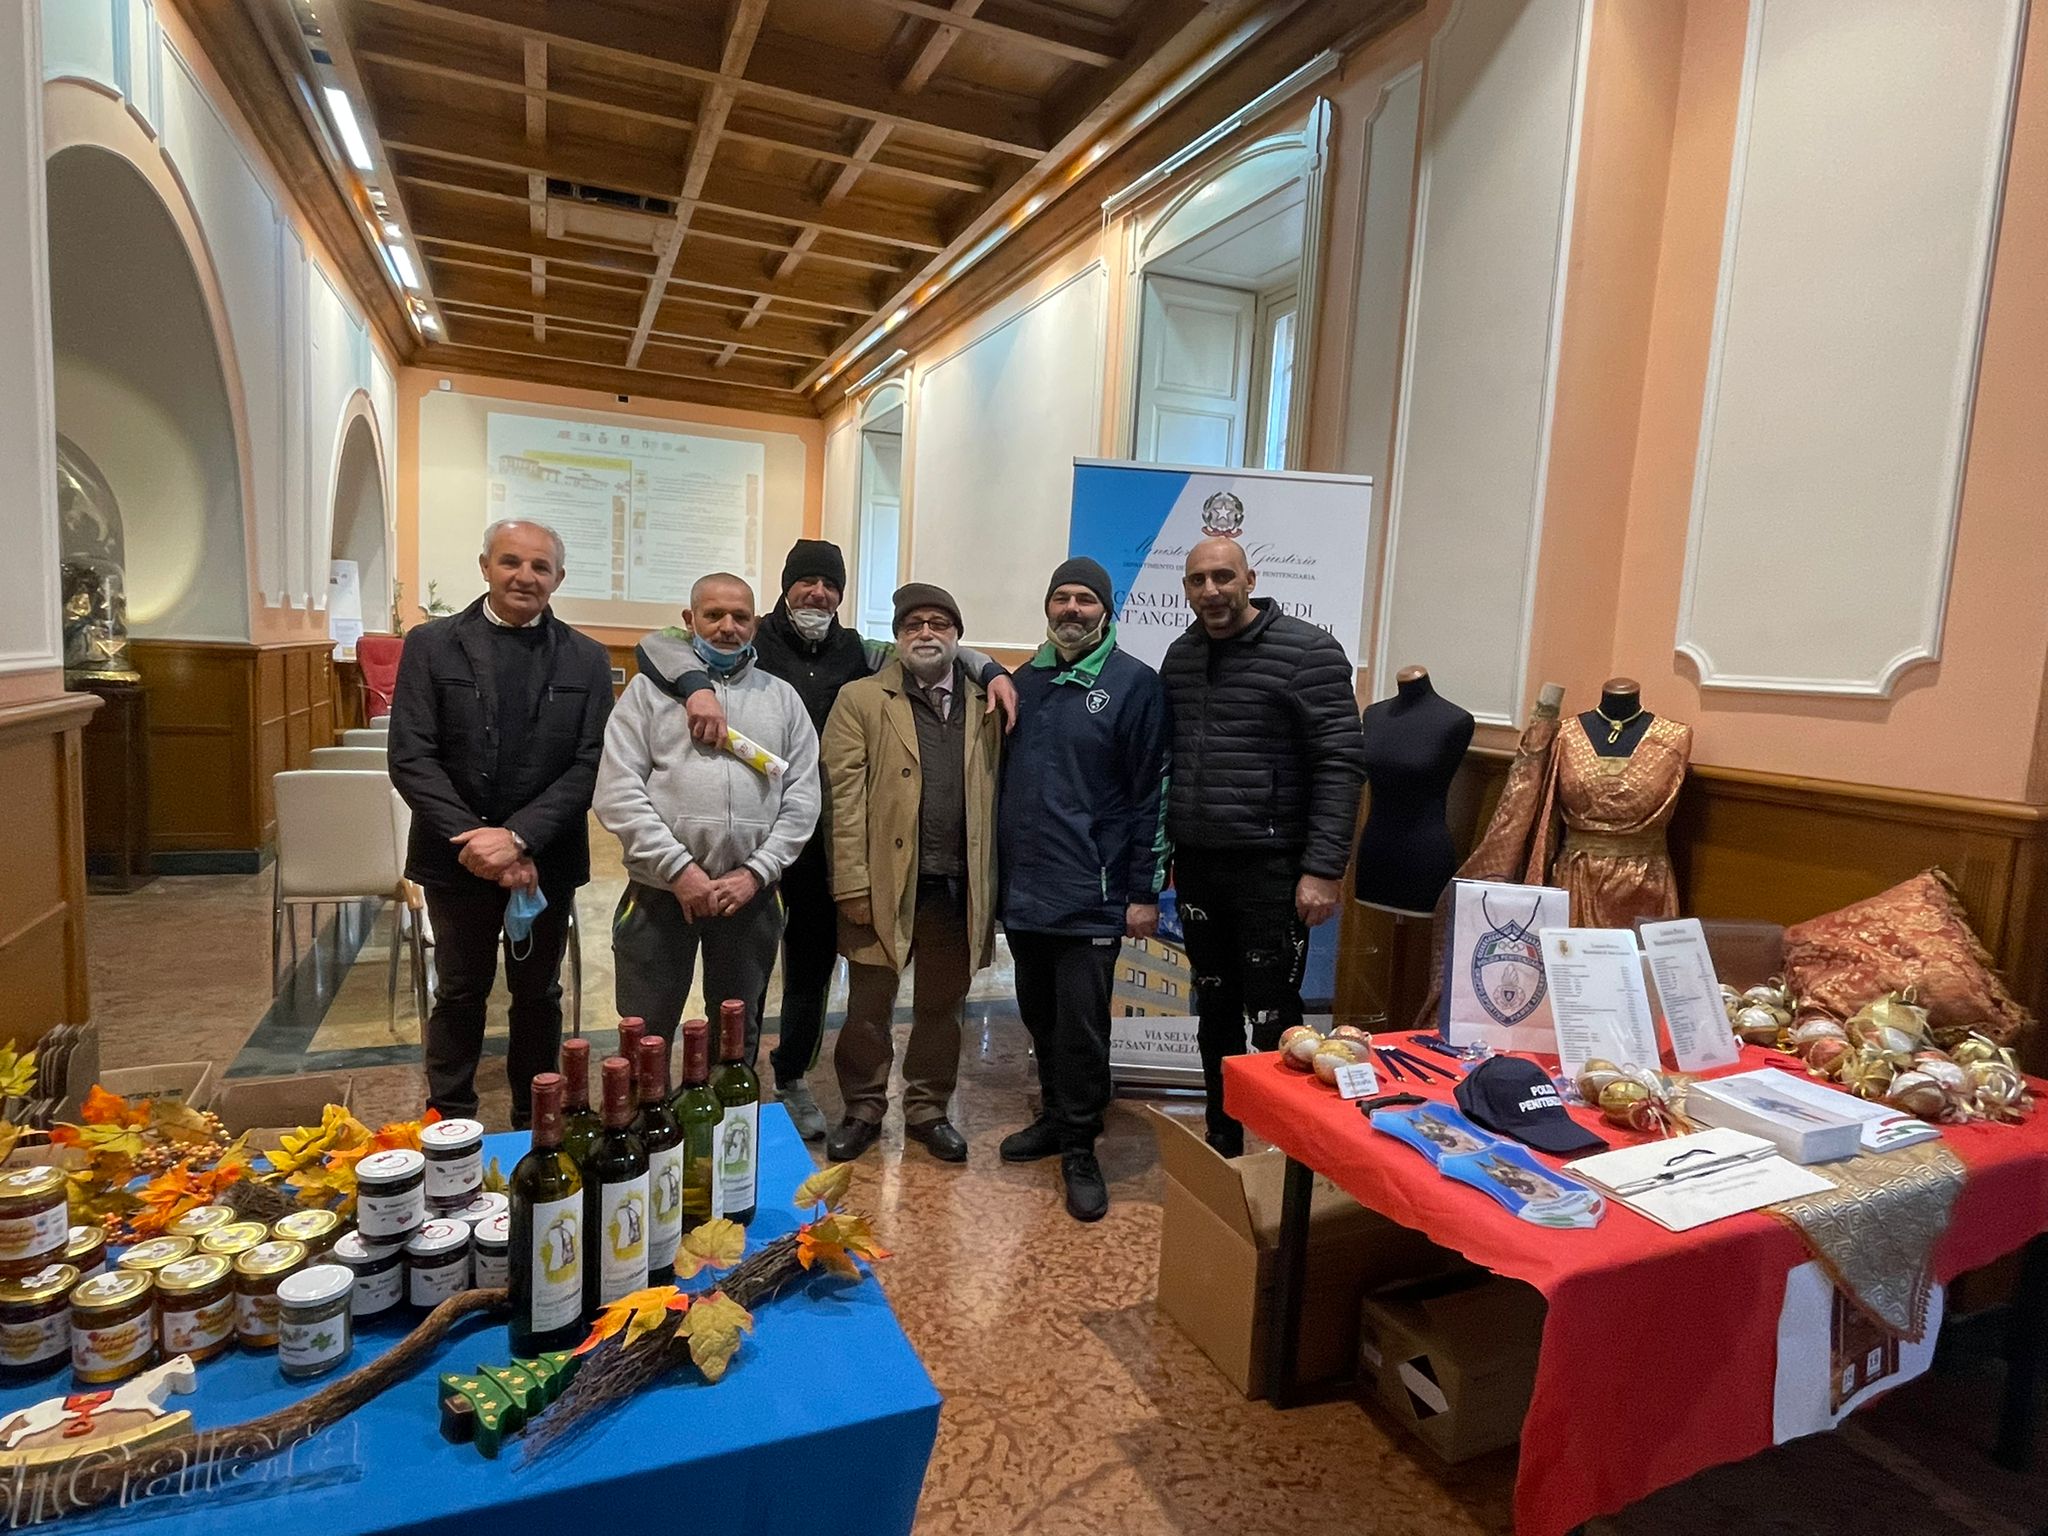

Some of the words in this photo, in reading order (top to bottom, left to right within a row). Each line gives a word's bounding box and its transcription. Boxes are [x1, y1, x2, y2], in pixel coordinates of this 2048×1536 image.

[1114, 590, 1157, 607] CASA
[1161, 593, 1180, 609] DI
[1295, 603, 1313, 618] DI
[1145, 1030, 1162, 1041] VIA
